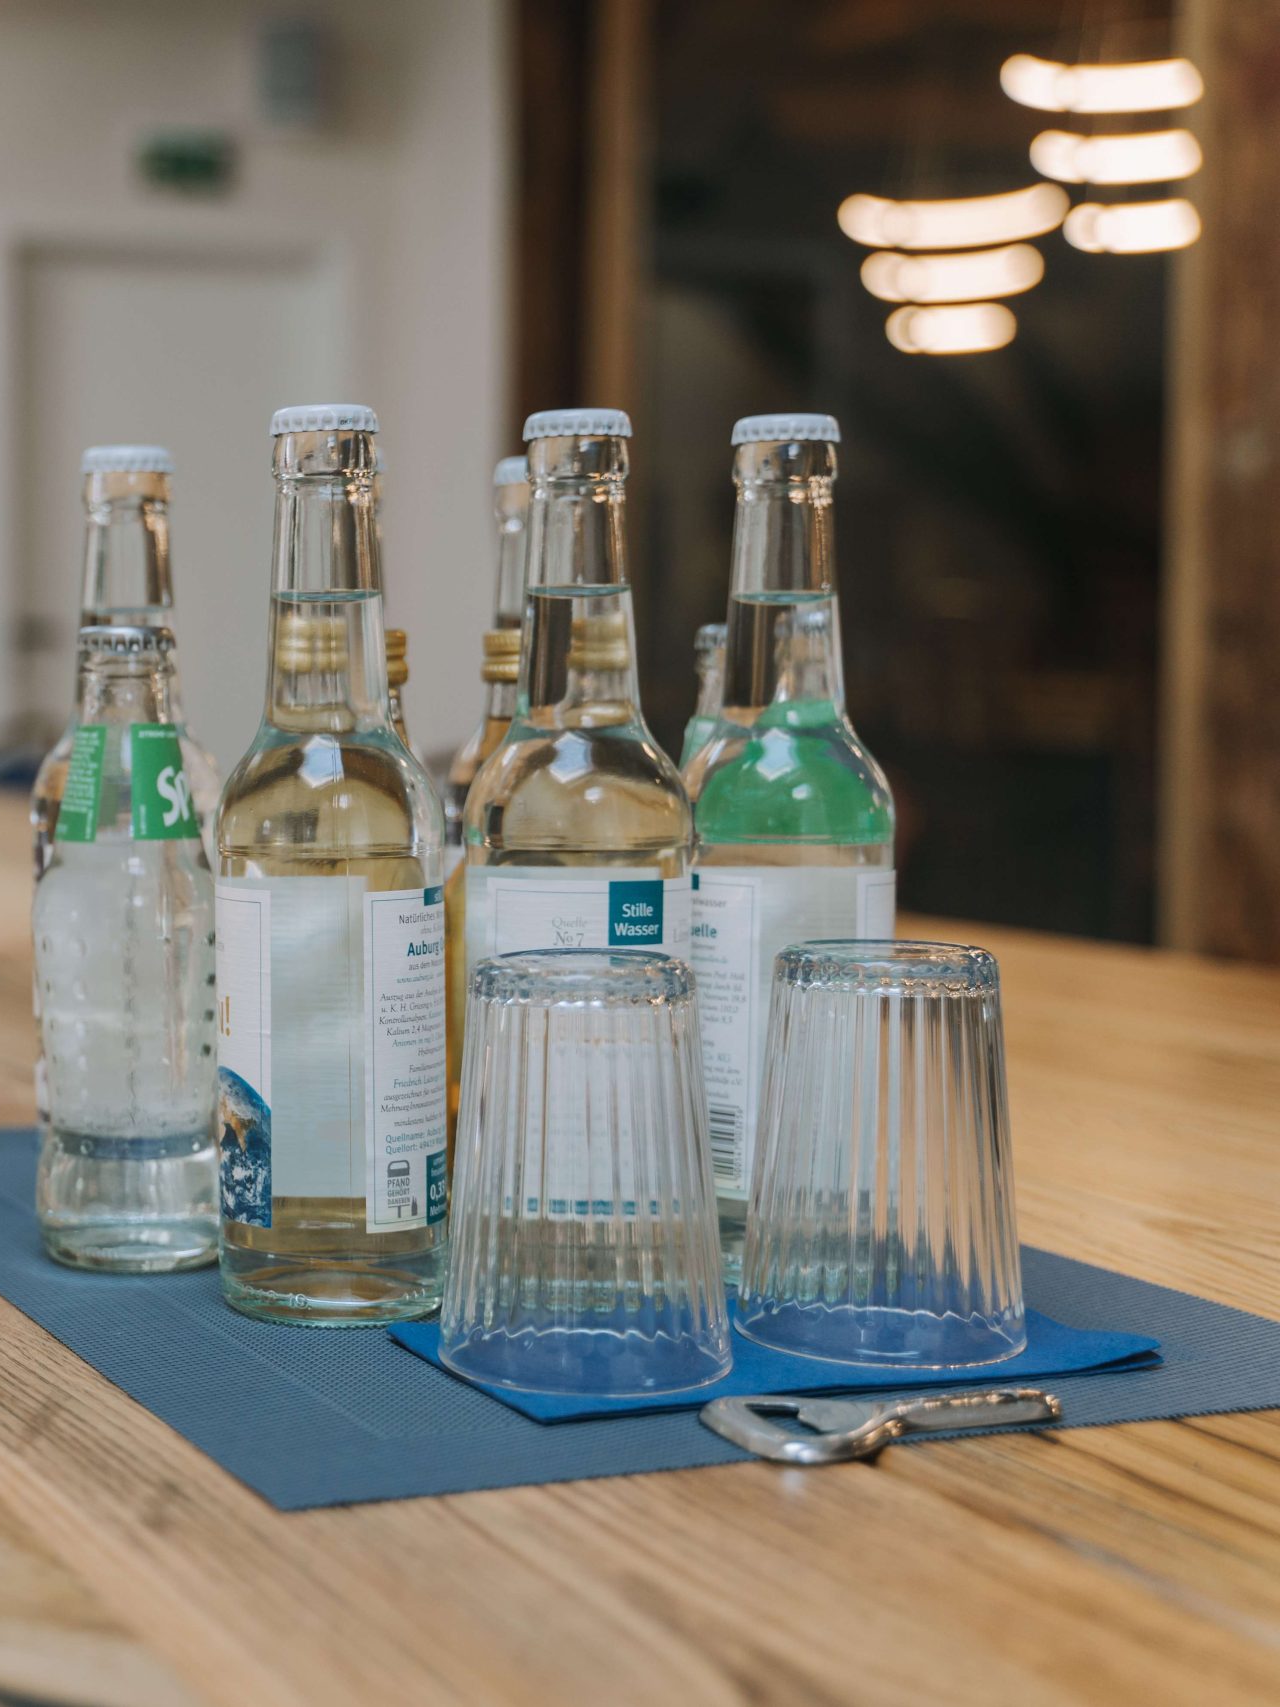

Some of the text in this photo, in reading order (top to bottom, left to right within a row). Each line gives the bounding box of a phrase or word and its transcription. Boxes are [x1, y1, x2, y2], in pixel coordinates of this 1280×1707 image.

[621, 902, 654, 918] Stille
[614, 922, 660, 937] Wasser
[576, 932, 585, 947] 7
[407, 940, 440, 957] Auburg
[387, 1027, 410, 1036] Kalium
[385, 1143, 418, 1155] Quellort:
[387, 1177, 410, 1189] PFAND
[387, 1188, 410, 1198] GEHÖRT
